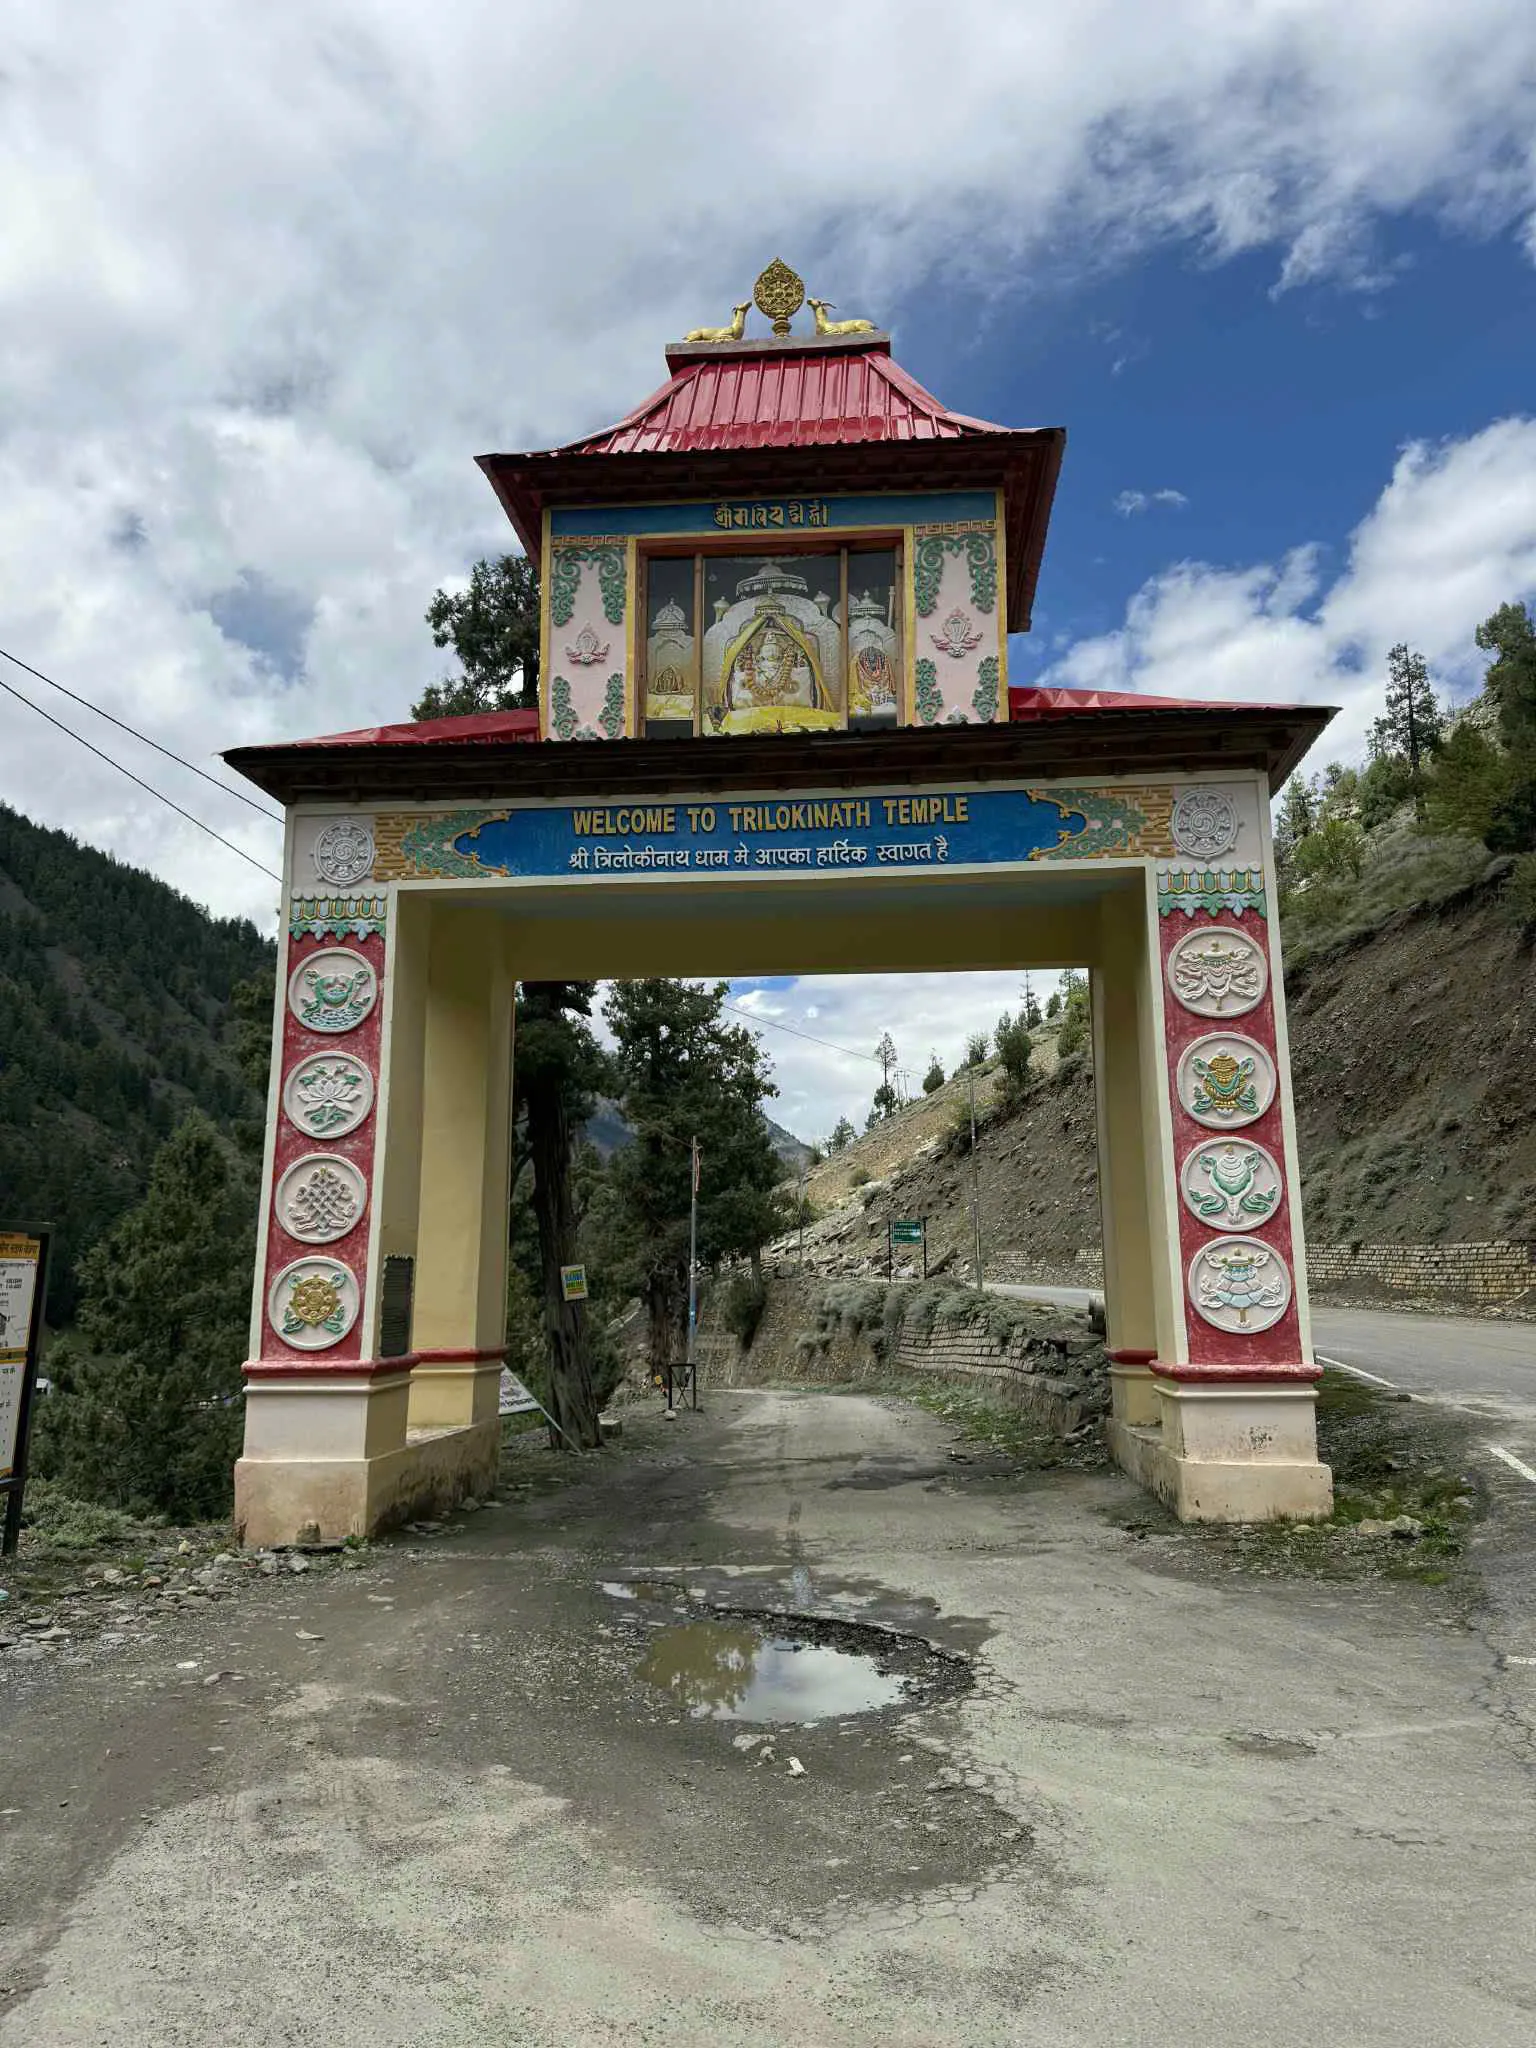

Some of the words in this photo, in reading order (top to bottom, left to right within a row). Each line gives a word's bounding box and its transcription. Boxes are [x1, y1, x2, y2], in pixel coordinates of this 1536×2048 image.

[573, 807, 676, 835] WELCOME
[687, 807, 716, 833] TO
[728, 800, 871, 832] TRILOKINATH
[882, 796, 969, 825] TEMPLE
[568, 846, 590, 869] श्री
[593, 844, 691, 869] त्रिलोकीनाथ
[695, 848, 730, 867] धाम
[754, 847, 812, 866] आपका
[816, 838, 868, 867] हार्दिक
[876, 843, 932, 862] स्वागत
[933, 834, 949, 862] है
